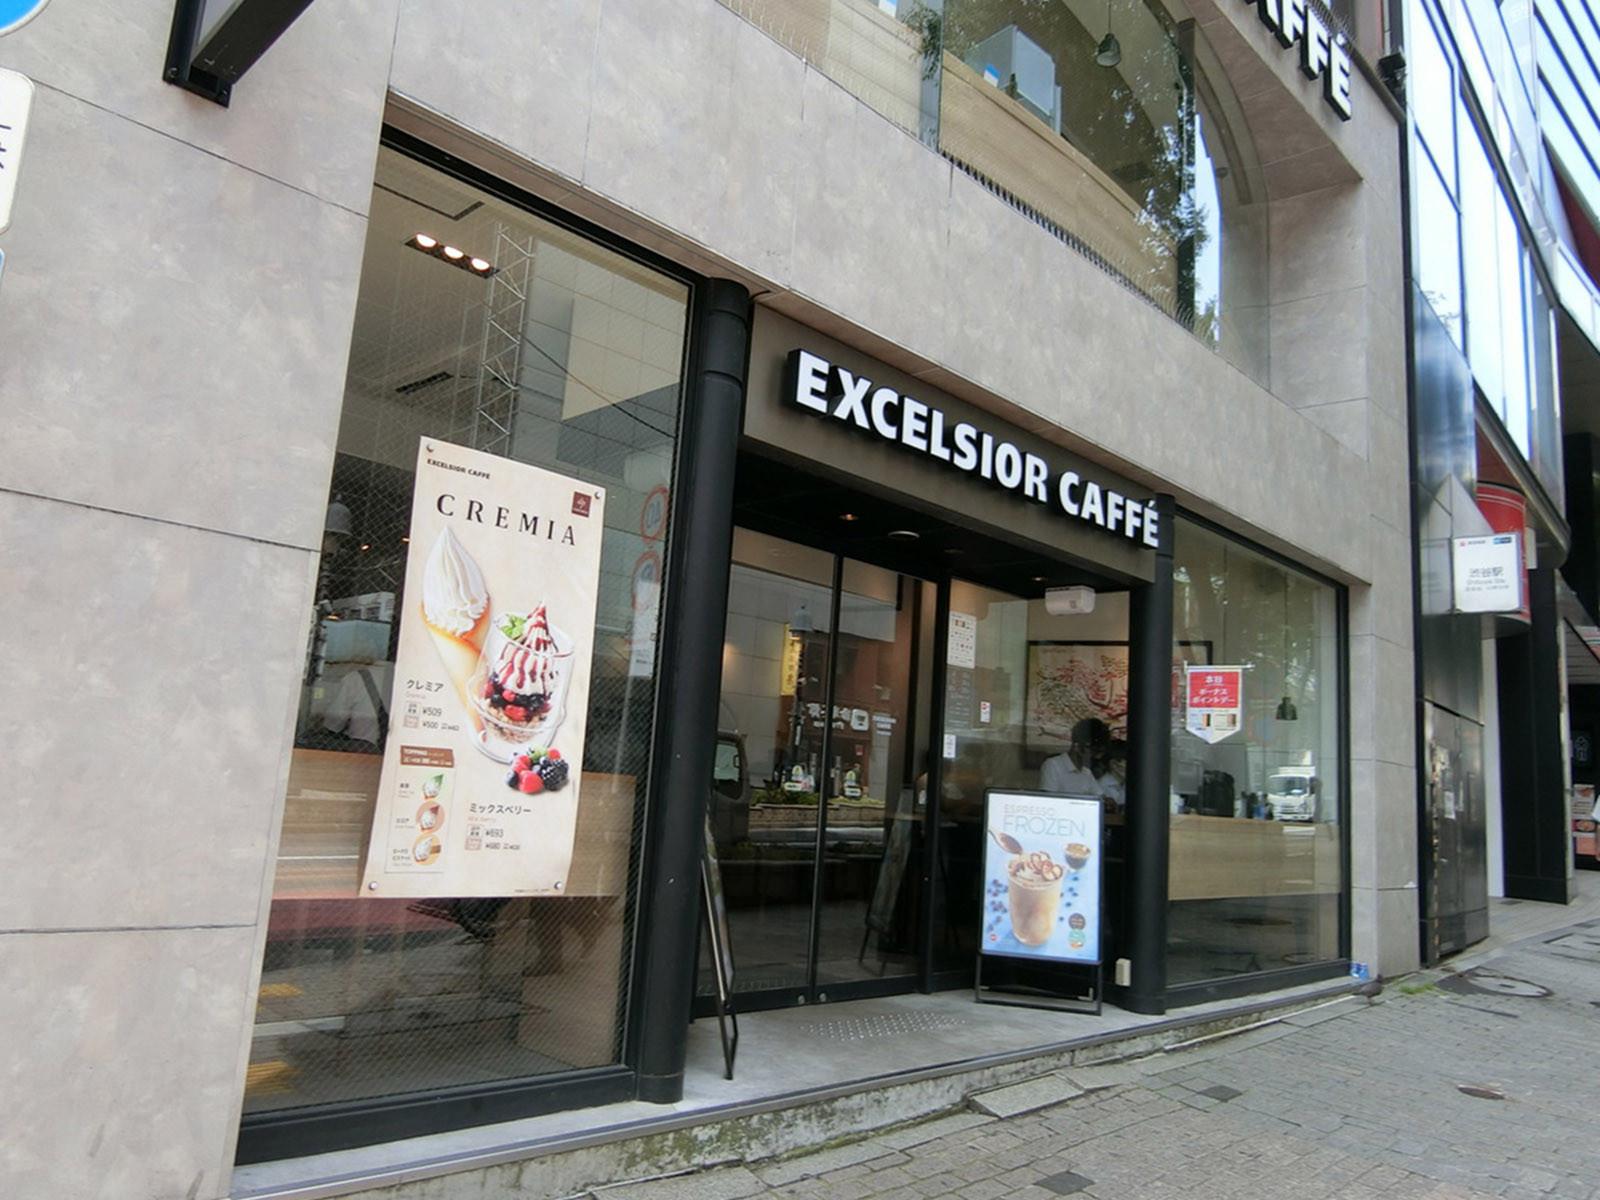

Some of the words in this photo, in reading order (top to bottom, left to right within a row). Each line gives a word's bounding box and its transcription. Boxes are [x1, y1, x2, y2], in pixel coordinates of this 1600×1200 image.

[796, 350, 1047, 502] EXCELSIOR
[1058, 471, 1159, 548] CAFFÉ
[426, 458, 466, 473] EXCELSIOR
[436, 493, 576, 546] CREMIA
[406, 679, 444, 692] クレミア
[469, 802, 532, 815] ミックスベリー
[1002, 814, 1086, 837] FROZEN
